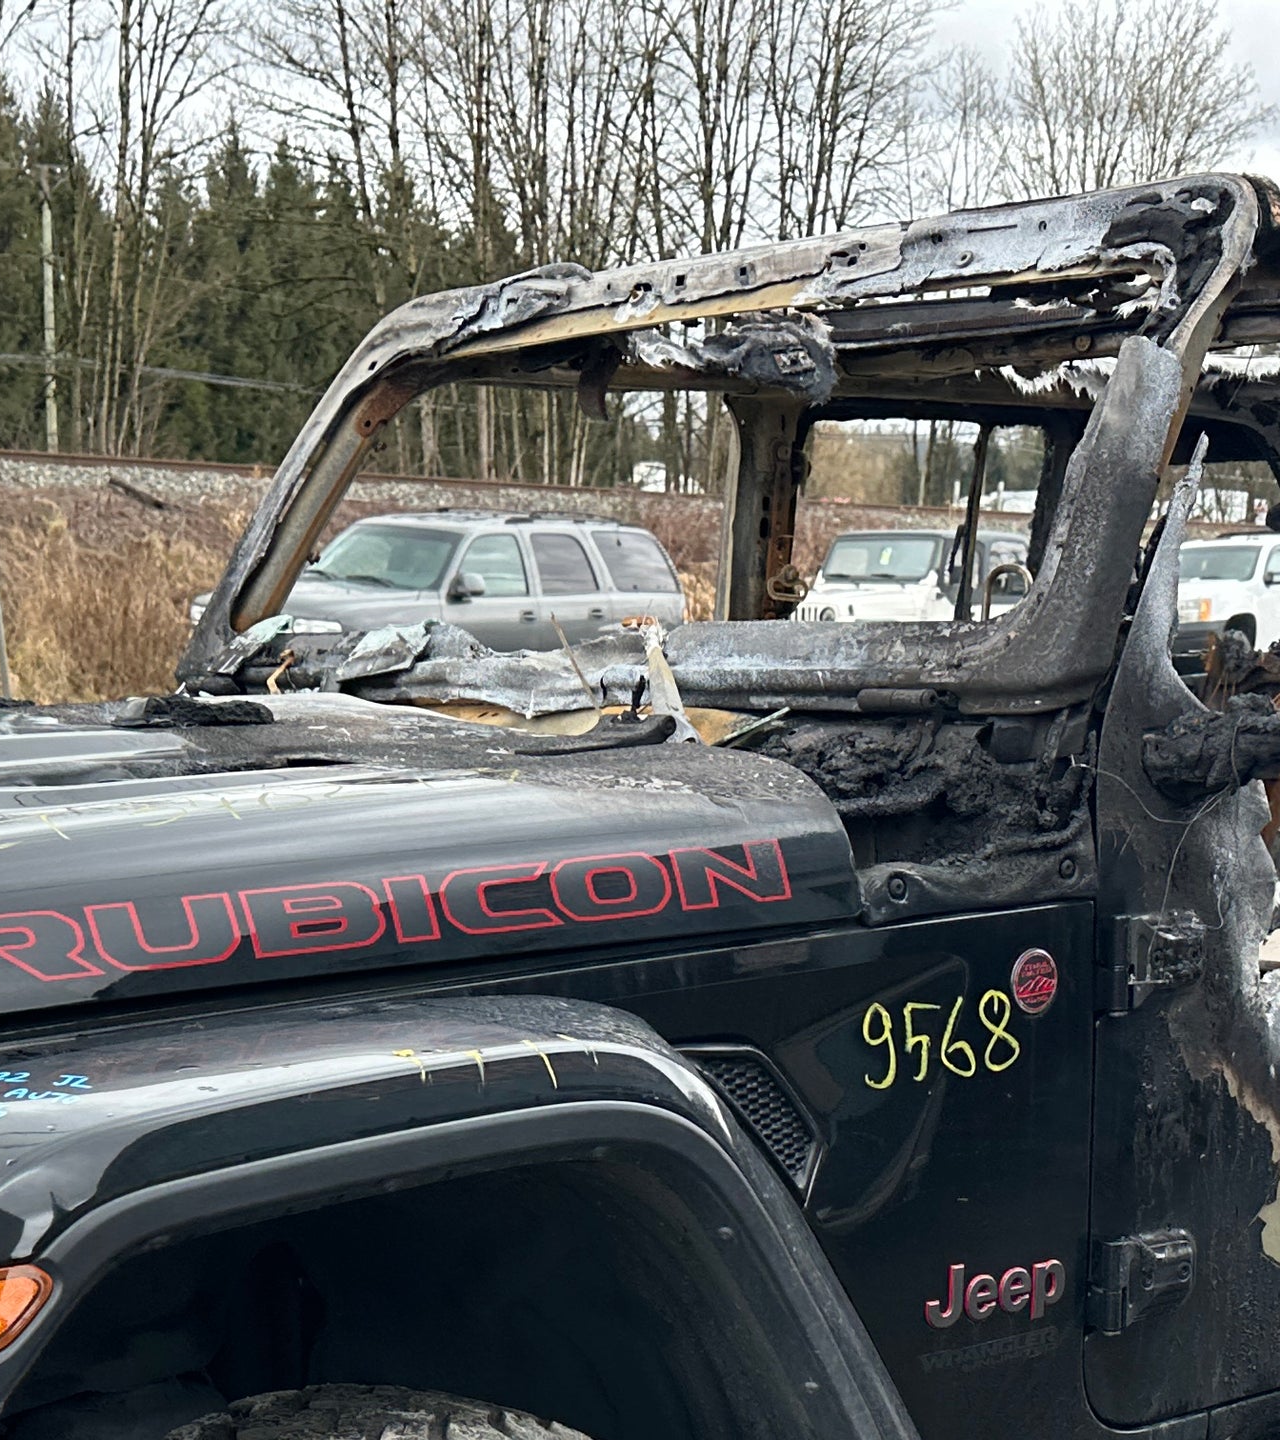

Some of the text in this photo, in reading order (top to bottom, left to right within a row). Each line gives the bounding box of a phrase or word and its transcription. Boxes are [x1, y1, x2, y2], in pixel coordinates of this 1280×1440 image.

[863, 989, 1020, 1089] 9568
[4, 1088, 82, 1104] AUTO
[53, 1075, 93, 1089] JL
[925, 1259, 1065, 1328] Jeep
